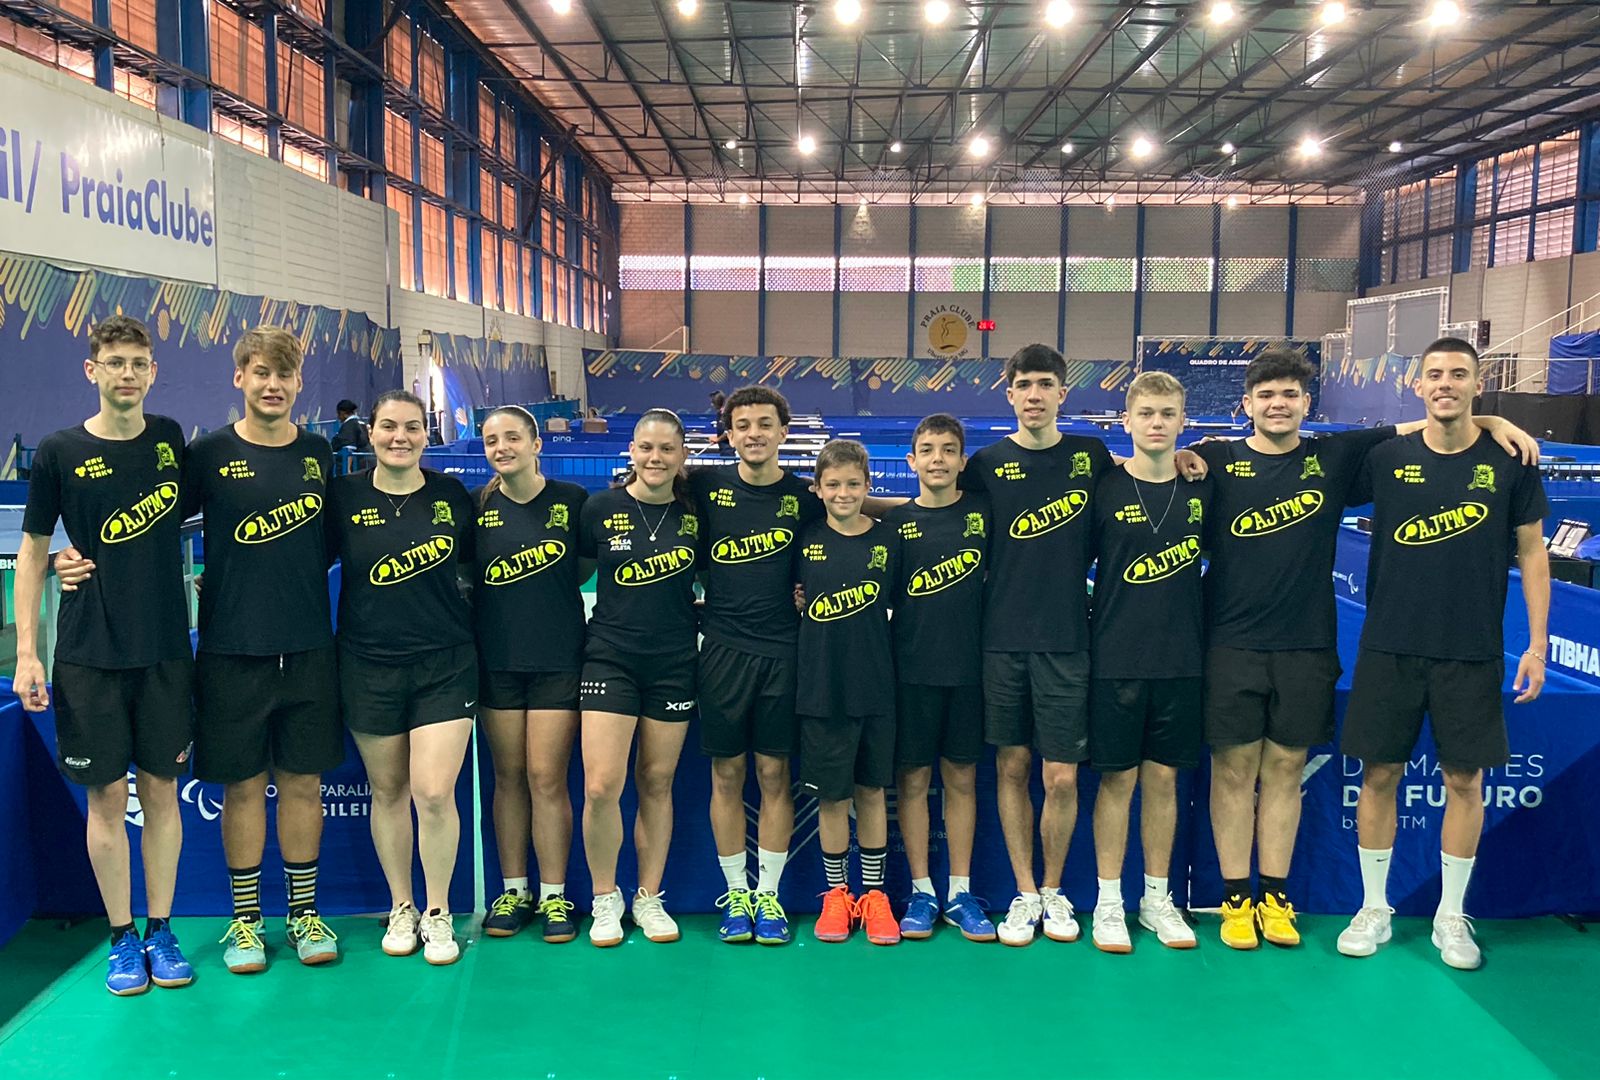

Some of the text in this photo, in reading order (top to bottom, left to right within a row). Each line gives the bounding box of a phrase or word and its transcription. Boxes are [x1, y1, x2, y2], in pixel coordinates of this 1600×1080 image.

[61, 151, 213, 247] PraiaClube
[920, 304, 976, 328] PRAIA CLUBE
[119, 490, 166, 533] AJTM
[256, 499, 307, 536] AJTM
[1028, 497, 1073, 532] AJTM
[1252, 497, 1306, 530] AJTM
[1417, 507, 1467, 539] AJTM
[389, 541, 440, 577] AJTM
[499, 545, 547, 578] AJTM
[728, 532, 775, 558] AJTM
[1145, 541, 1191, 577] AJTM
[632, 550, 680, 580] AJTM
[922, 555, 966, 589] AJTM
[823, 586, 865, 616] AJTM
[1405, 785, 1543, 808] FUURO
